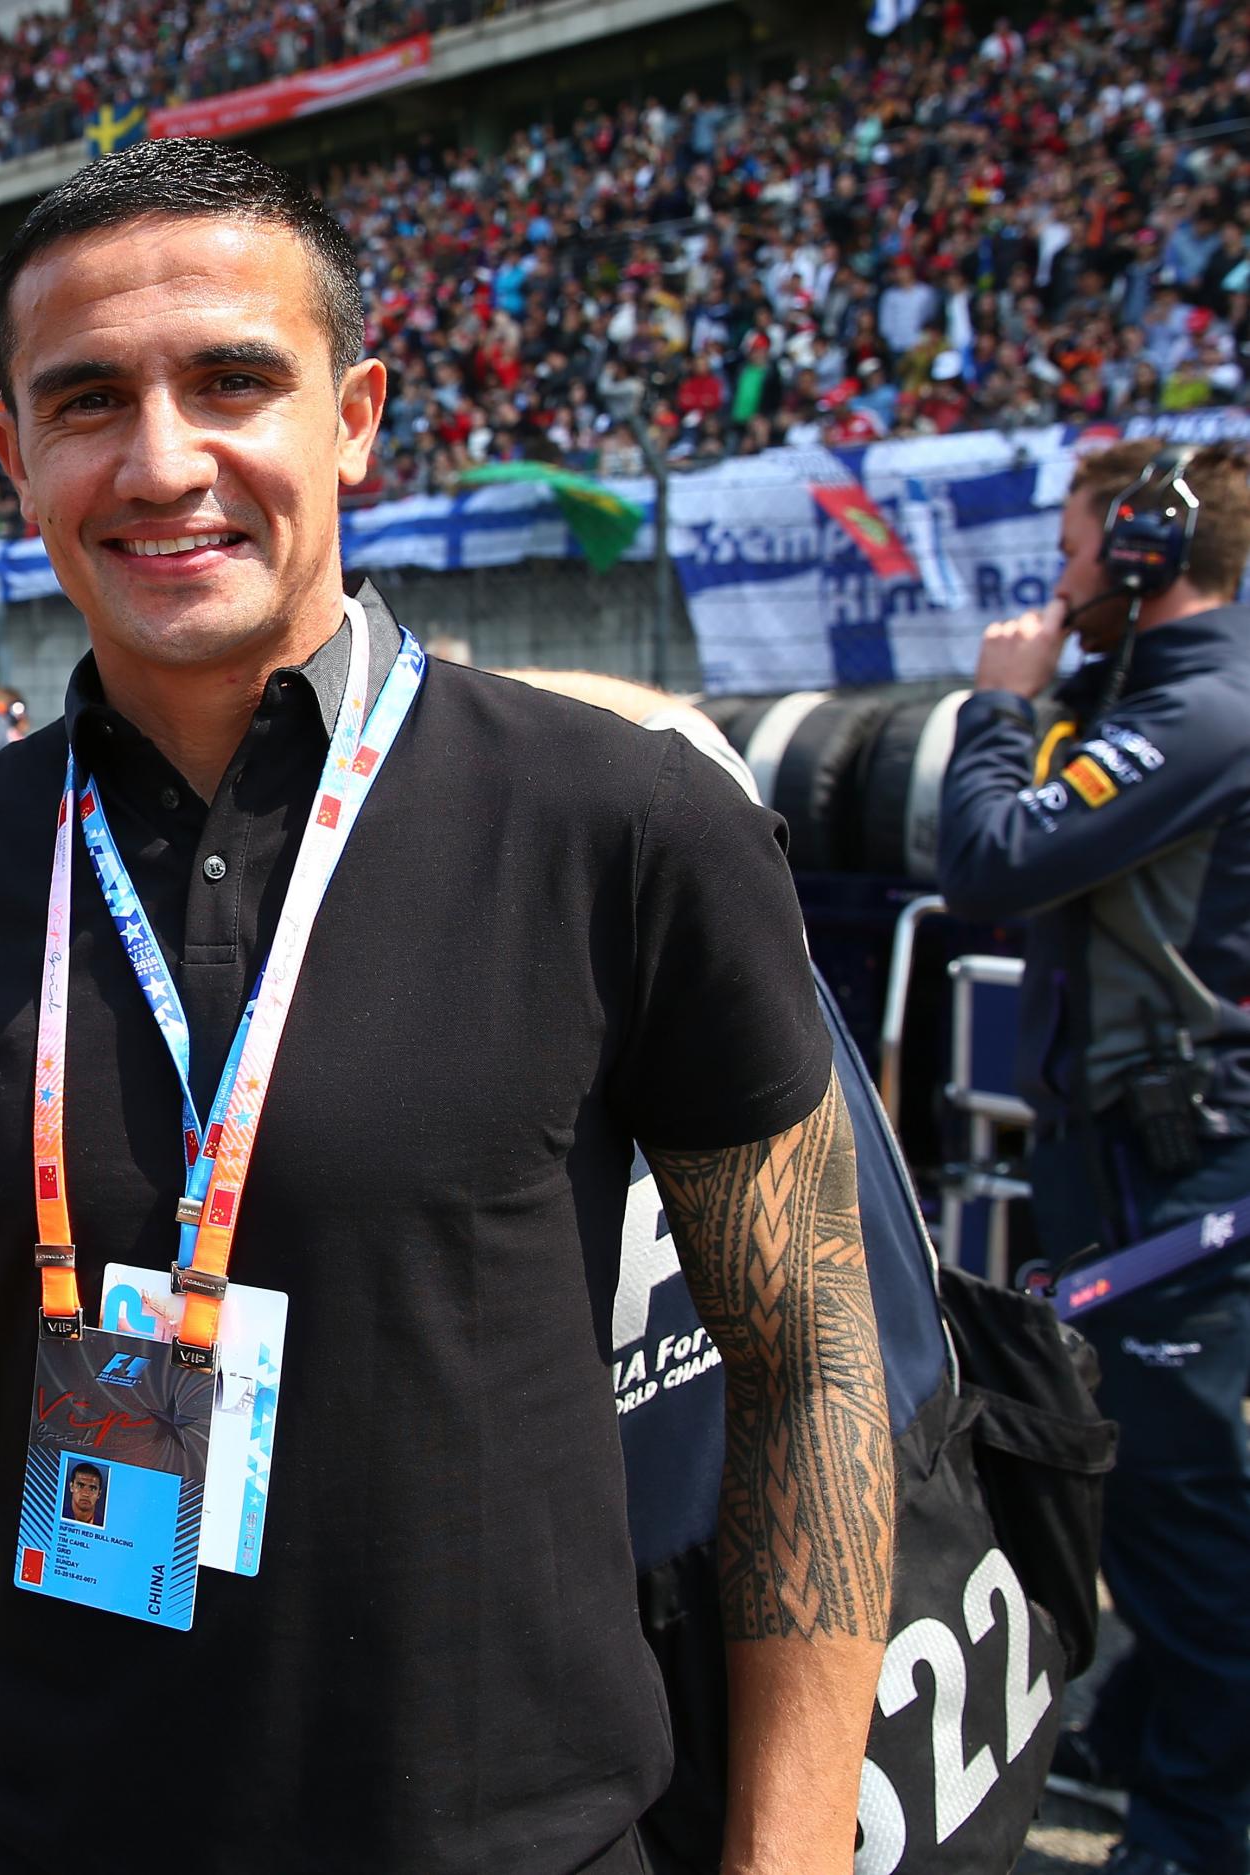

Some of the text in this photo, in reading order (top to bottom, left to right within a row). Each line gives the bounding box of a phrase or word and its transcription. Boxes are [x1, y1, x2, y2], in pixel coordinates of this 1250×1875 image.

[129, 946, 154, 963] VIP
[133, 956, 159, 972] 2015
[218, 1068, 233, 1102] FORMULA
[47, 1321, 72, 1335] VIP
[179, 1349, 207, 1365] VIP
[655, 1327, 713, 1373] For
[37, 1385, 155, 1449] Vip
[58, 1525, 81, 1536] INFINITI
[81, 1530, 94, 1538] RED
[94, 1533, 110, 1543] BULL
[110, 1537, 134, 1548] RACING
[58, 1536, 69, 1544] TIM
[69, 1538, 90, 1549] CAHILL
[56, 1546, 72, 1555] GRID
[55, 1557, 79, 1568] SUNDAY
[147, 1564, 166, 1616] CHINA
